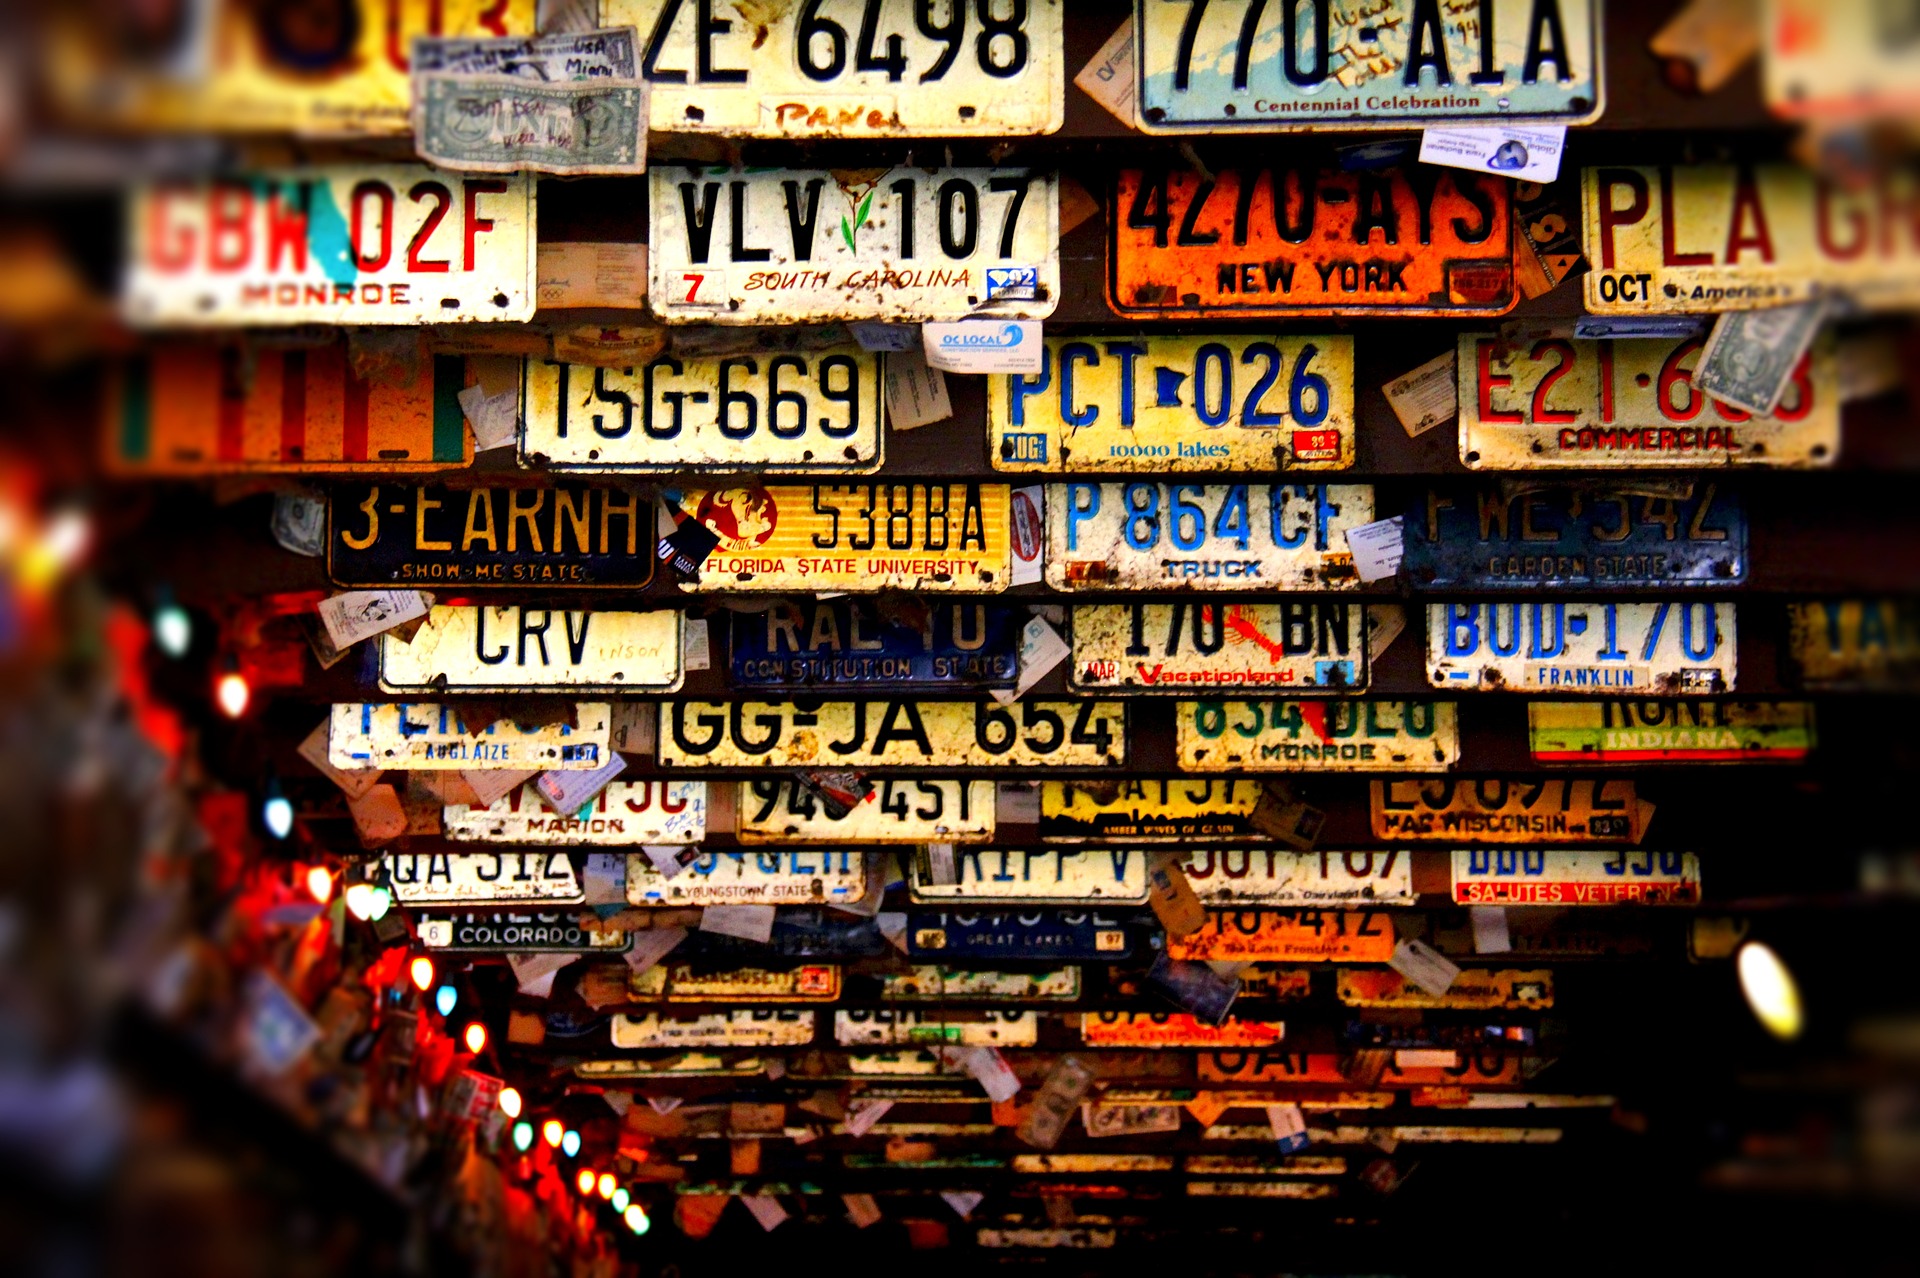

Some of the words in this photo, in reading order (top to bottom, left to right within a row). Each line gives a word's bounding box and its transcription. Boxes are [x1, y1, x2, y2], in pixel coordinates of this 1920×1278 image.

[797, 0, 1030, 84] 6498
[1254, 98, 1360, 113] Centennial
[1366, 94, 1480, 111] Celebration
[350, 181, 508, 274] 02F
[679, 181, 826, 264] VLV
[890, 177, 1029, 260] 107
[1598, 167, 1776, 269] PLA
[744, 271, 828, 291] SOUTH
[846, 268, 971, 289] CAROLINA
[1218, 261, 1296, 295] NEW
[1315, 261, 1408, 295] YORK
[1599, 274, 1652, 302] OCT
[242, 283, 412, 306] MONROE
[682, 274, 704, 303] 7
[943, 334, 960, 345] OC
[964, 334, 1002, 345] LOCAL
[1194, 342, 1331, 428] 026
[1109, 442, 1170, 457] 10000
[1176, 440, 1231, 457] lakes
[1558, 427, 1742, 452] COMMERCIAL
[402, 563, 503, 578] SHOW-ME
[513, 563, 581, 580] STATE
[705, 558, 786, 574] FLORIDA
[797, 558, 857, 574] STATE
[868, 558, 980, 576] UNIVERSITY
[1166, 560, 1262, 578] TRUCK
[1595, 555, 1666, 576] STATE
[743, 658, 912, 678] CONSTITUTION
[933, 655, 1008, 677] STATE
[1136, 664, 1295, 684] Vacationland
[1538, 667, 1635, 687] FRANKLIN
[1606, 730, 1742, 748] INDIANA
[425, 744, 510, 760] AUGLAIZE
[1261, 744, 1376, 760] MONROE
[526, 818, 625, 835] MARION
[1440, 812, 1567, 834] WISCONSIN
[684, 884, 767, 899] YOUNGSTOWN
[772, 884, 808, 898] STATE
[1302, 888, 1360, 901] Dairyland
[1468, 884, 1563, 902] SALUTES
[460, 927, 581, 944] COLORADO
[965, 933, 1014, 946] GREAT
